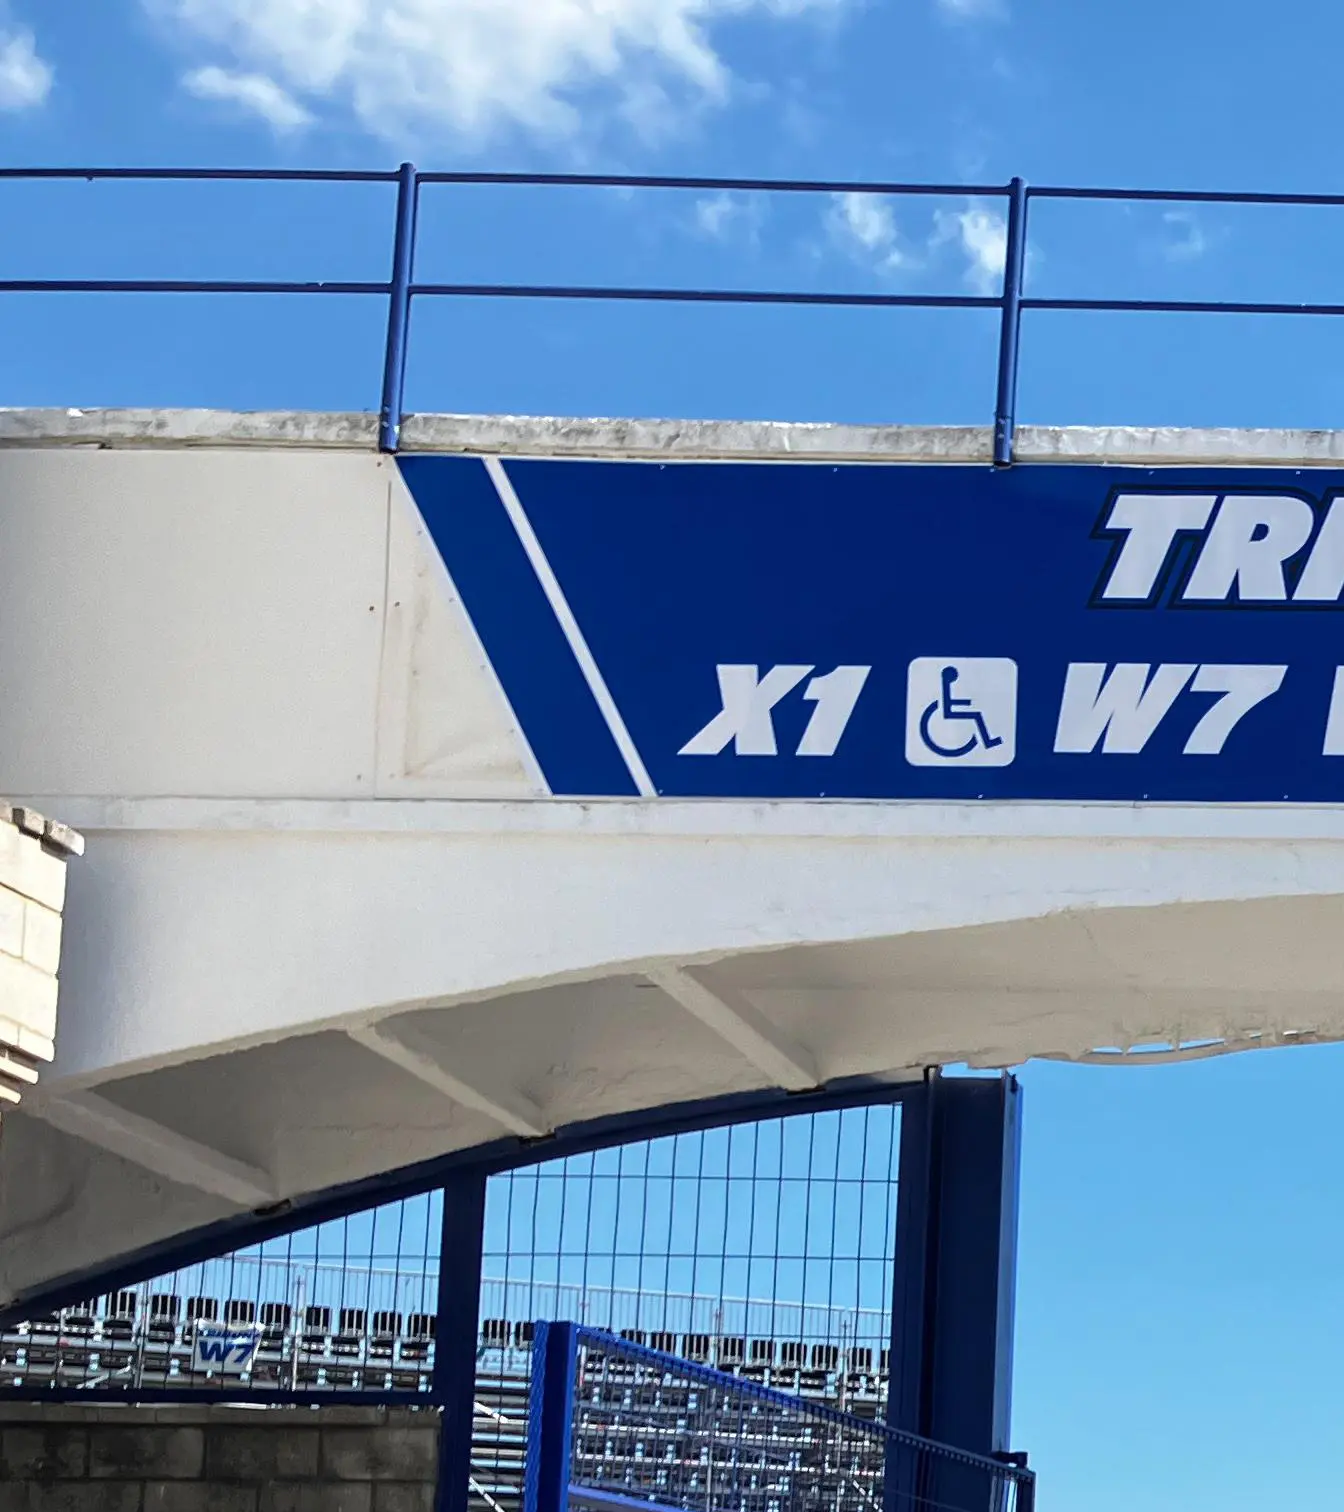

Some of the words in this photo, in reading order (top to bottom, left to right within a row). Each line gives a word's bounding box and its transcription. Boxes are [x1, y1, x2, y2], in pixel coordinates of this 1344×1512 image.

[677, 663, 872, 757] X1
[1052, 662, 1290, 755] W7
[198, 1341, 257, 1363] W7
